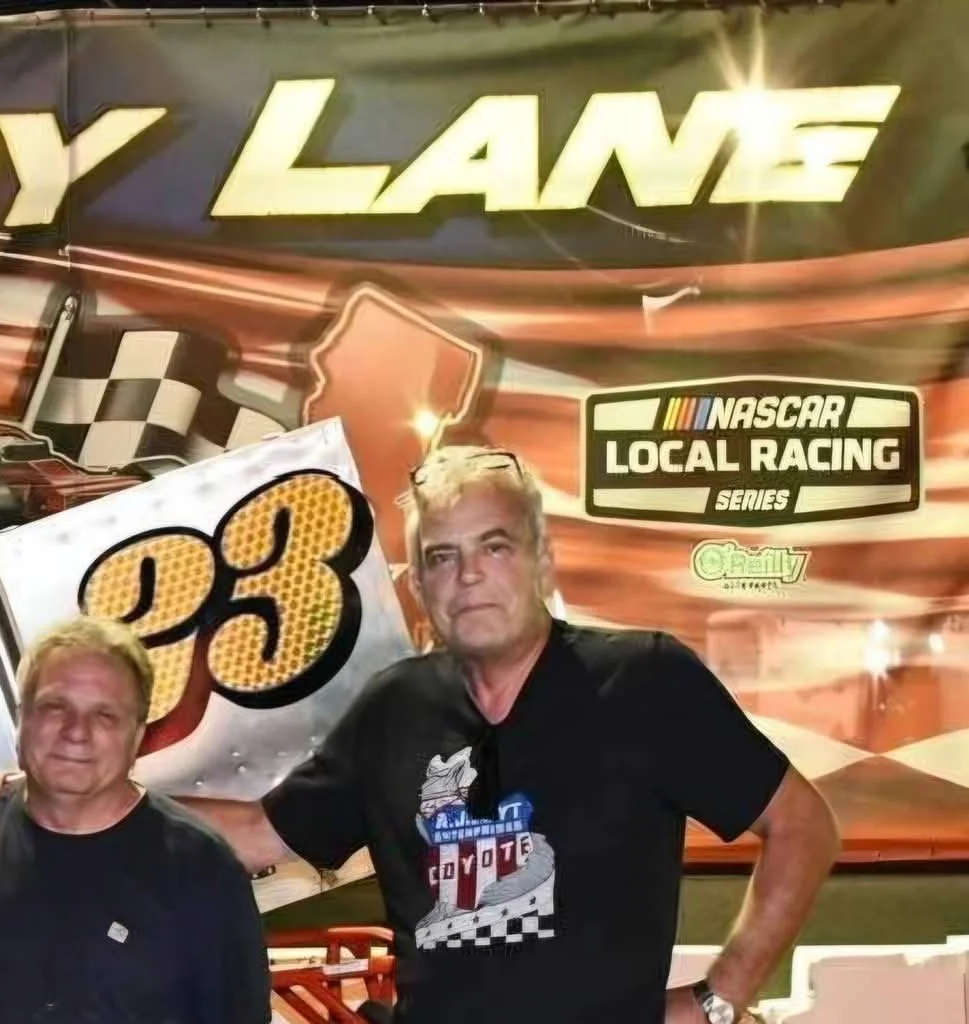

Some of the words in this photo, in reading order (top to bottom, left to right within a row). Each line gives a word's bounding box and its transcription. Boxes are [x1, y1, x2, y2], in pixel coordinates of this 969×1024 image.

[210, 77, 902, 218] LANE
[705, 394, 846, 430] NASCAR
[605, 438, 740, 474] LOCAL
[750, 437, 900, 472] RACING
[714, 488, 790, 512] SERIES
